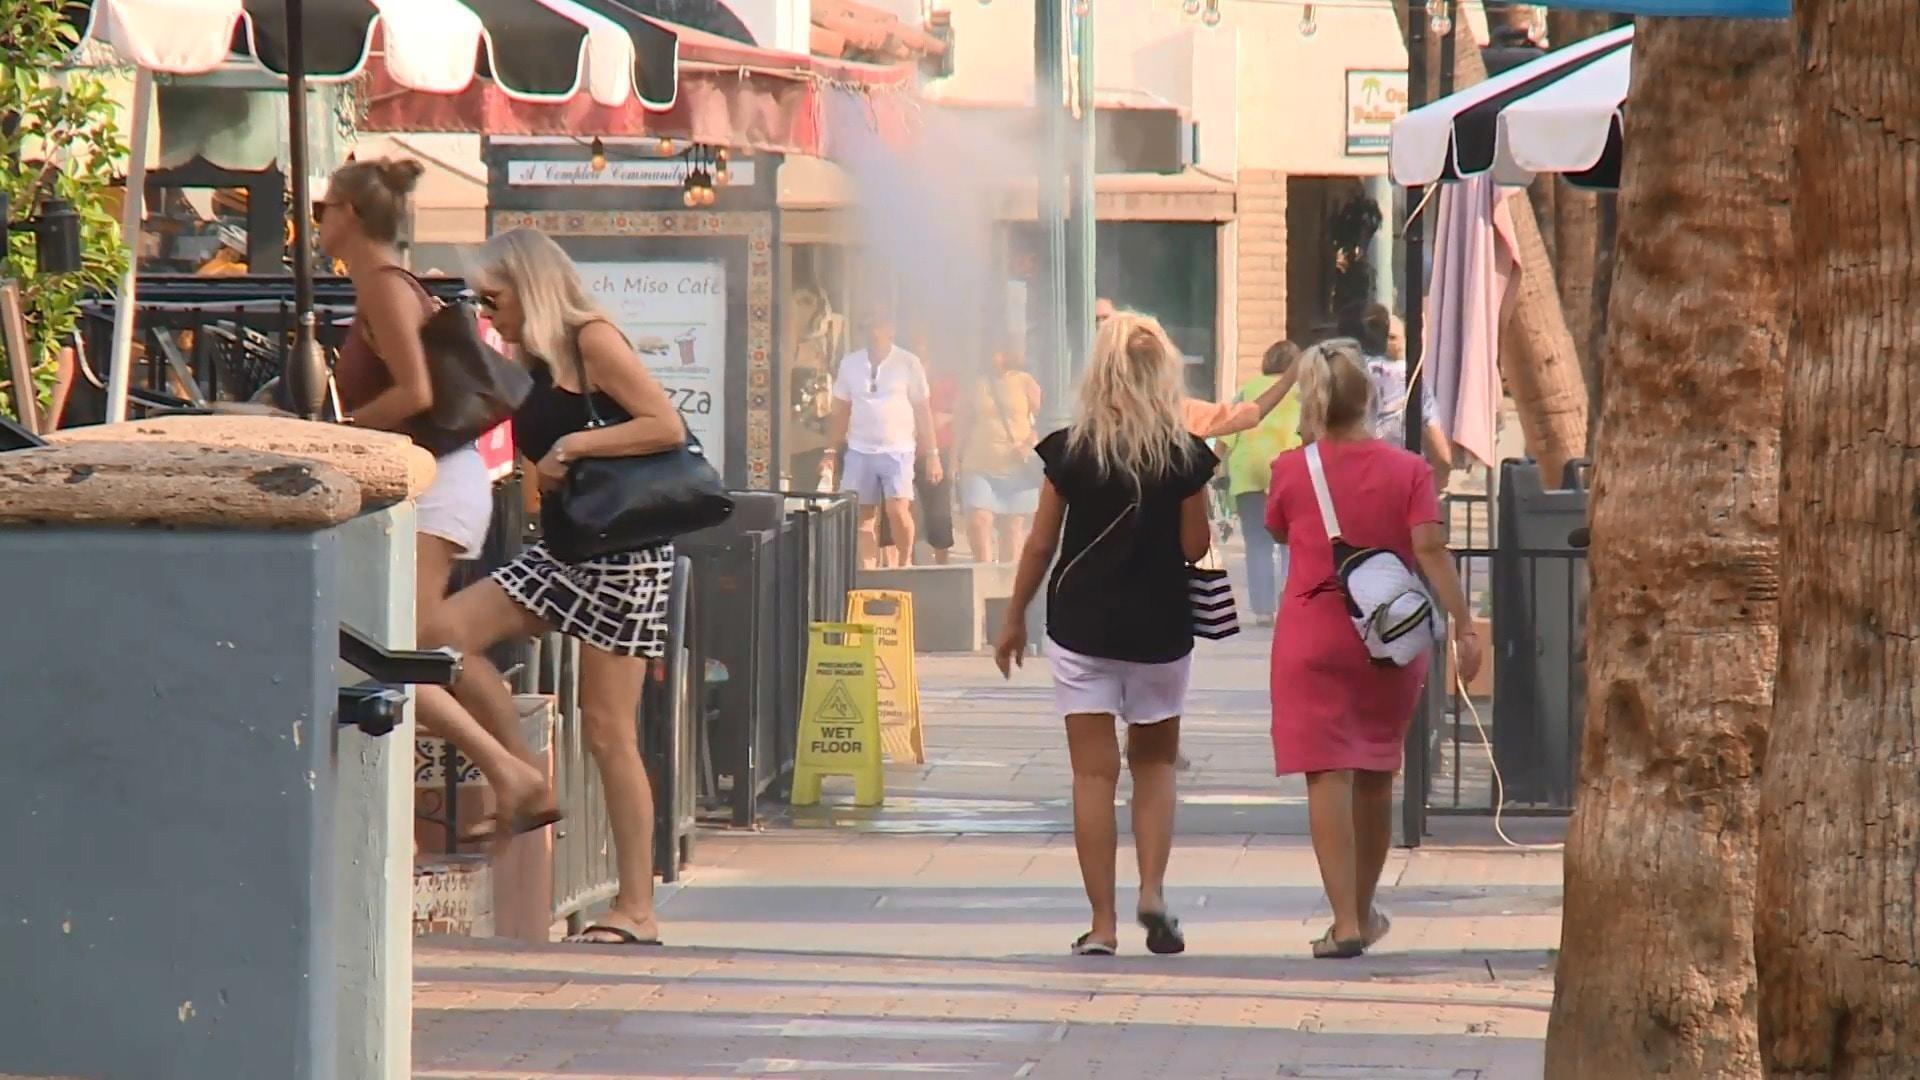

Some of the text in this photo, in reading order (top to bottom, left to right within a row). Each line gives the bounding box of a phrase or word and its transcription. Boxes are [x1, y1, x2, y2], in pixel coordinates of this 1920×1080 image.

[592, 276, 615, 293] ch
[624, 275, 668, 293] Miso
[663, 387, 712, 415] zza
[821, 727, 855, 739] WET
[811, 741, 862, 753] FLOOR
